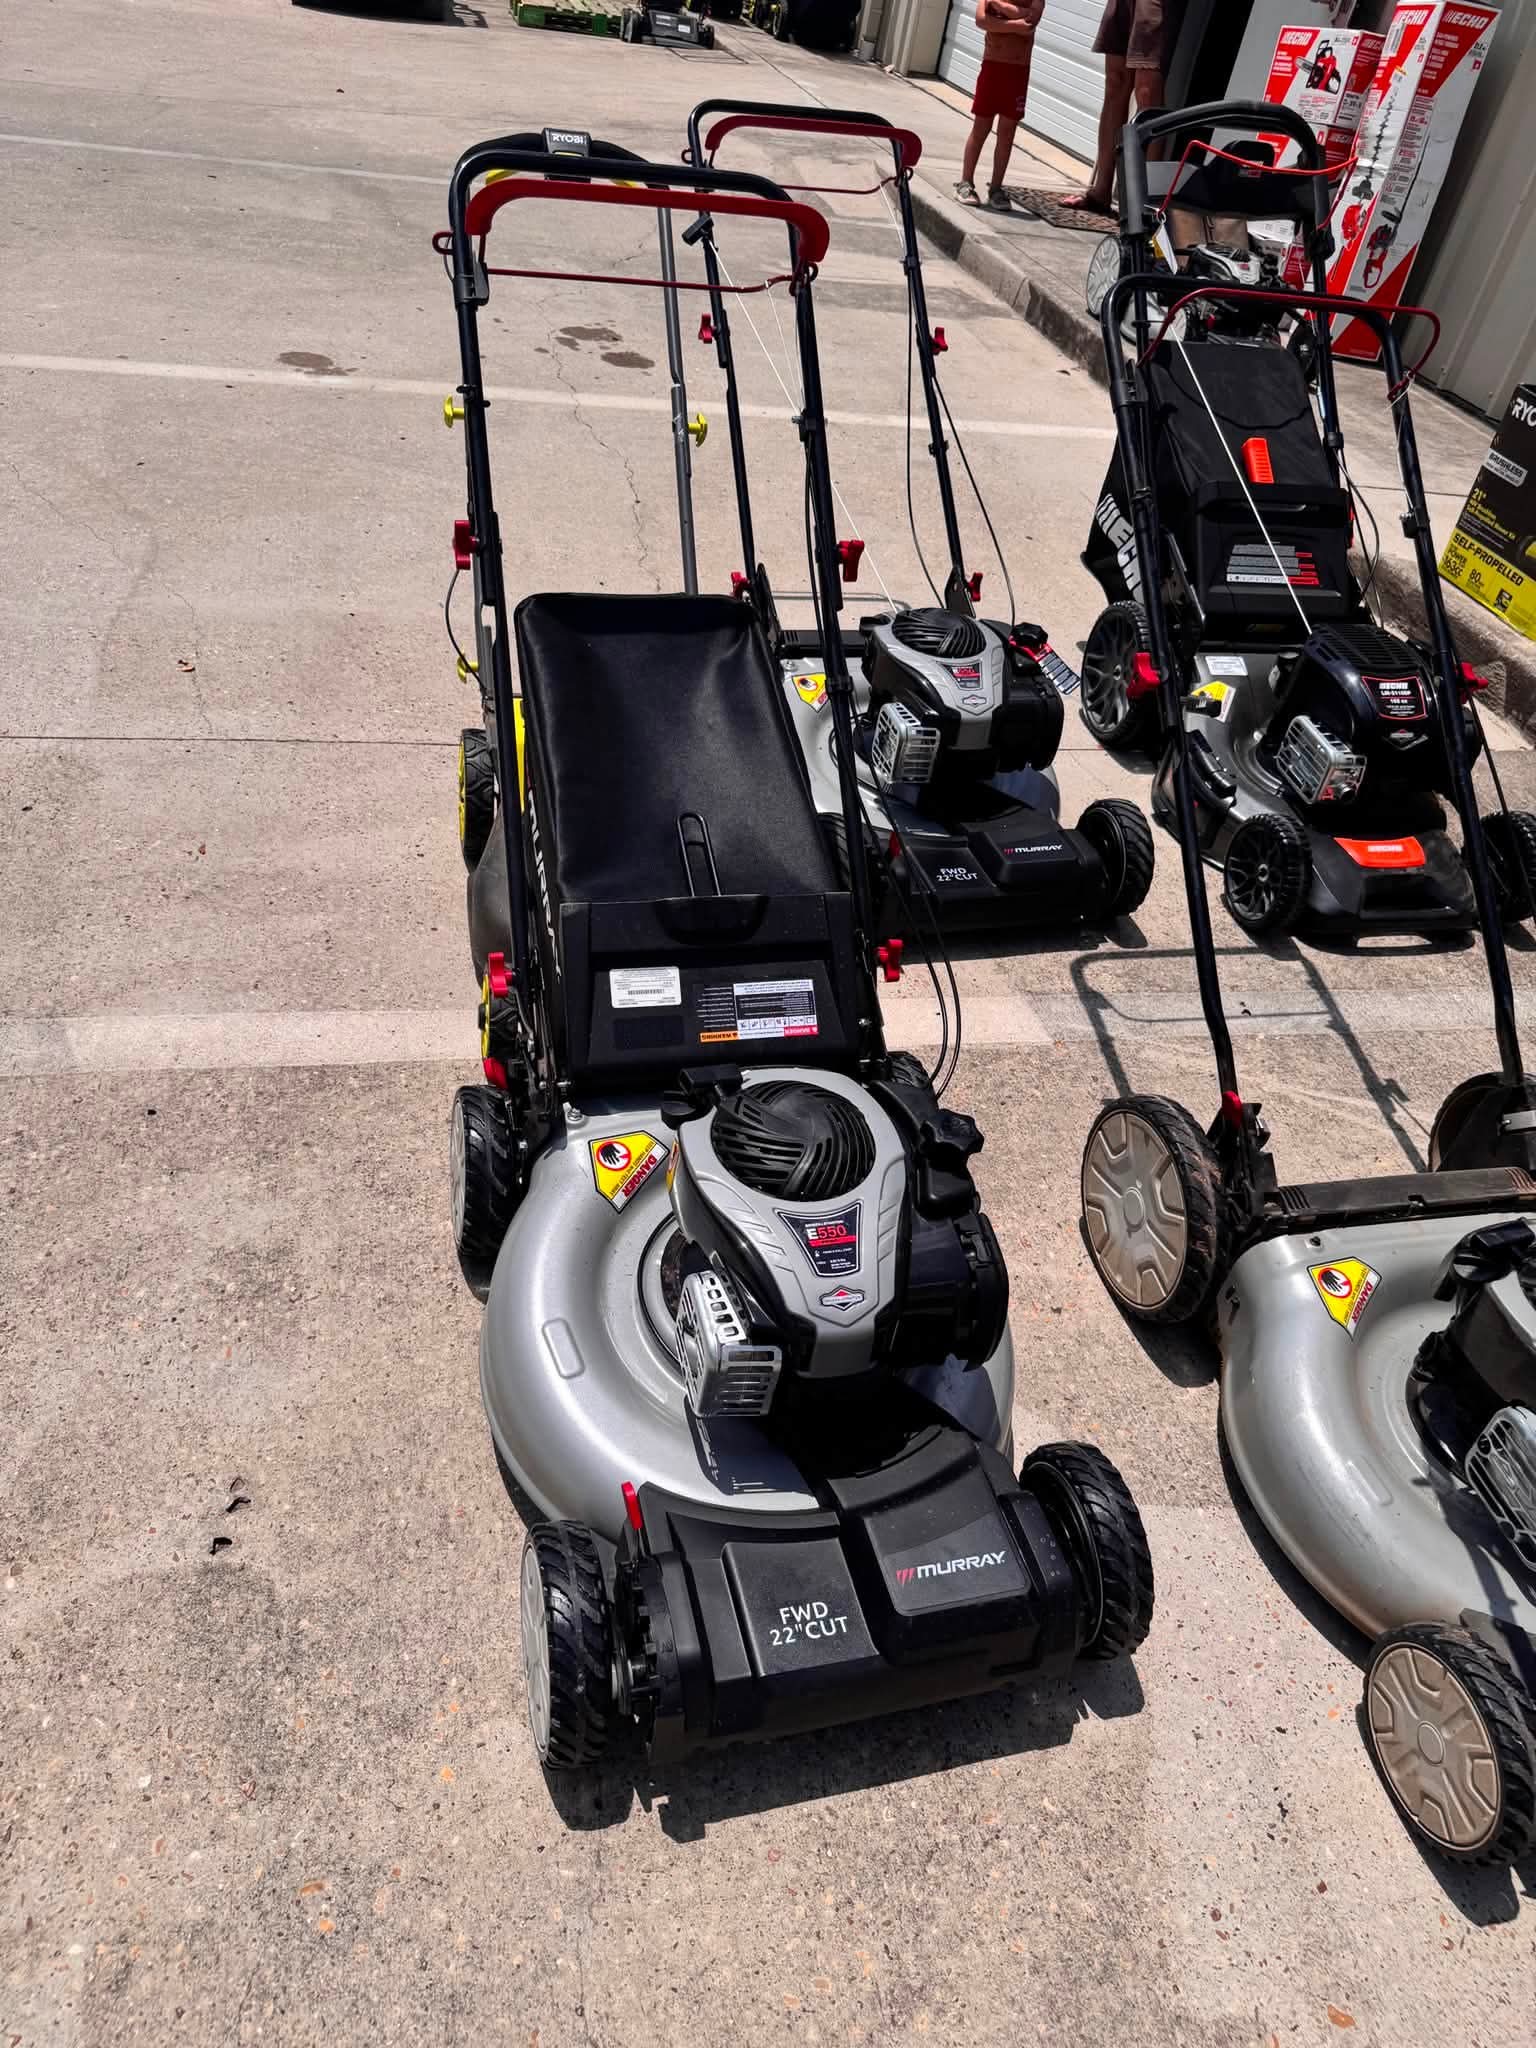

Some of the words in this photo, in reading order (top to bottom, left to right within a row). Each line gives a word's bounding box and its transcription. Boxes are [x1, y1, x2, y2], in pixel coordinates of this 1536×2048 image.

[1453, 12, 1489, 29] ECHO
[1286, 31, 1312, 46] ECHO
[551, 133, 584, 144] RYOBI
[1454, 533, 1524, 587] SELF-PROPELLED
[1470, 568, 1481, 584] 80
[1014, 844, 1063, 853] MURRAY
[939, 867, 967, 875] FWD
[622, 1153, 658, 1198] DANGER
[806, 1224, 847, 1240] E550
[1352, 1280, 1374, 1323] DANGER
[916, 1550, 1007, 1579] MURRAY
[779, 1601, 829, 1625] FWD
